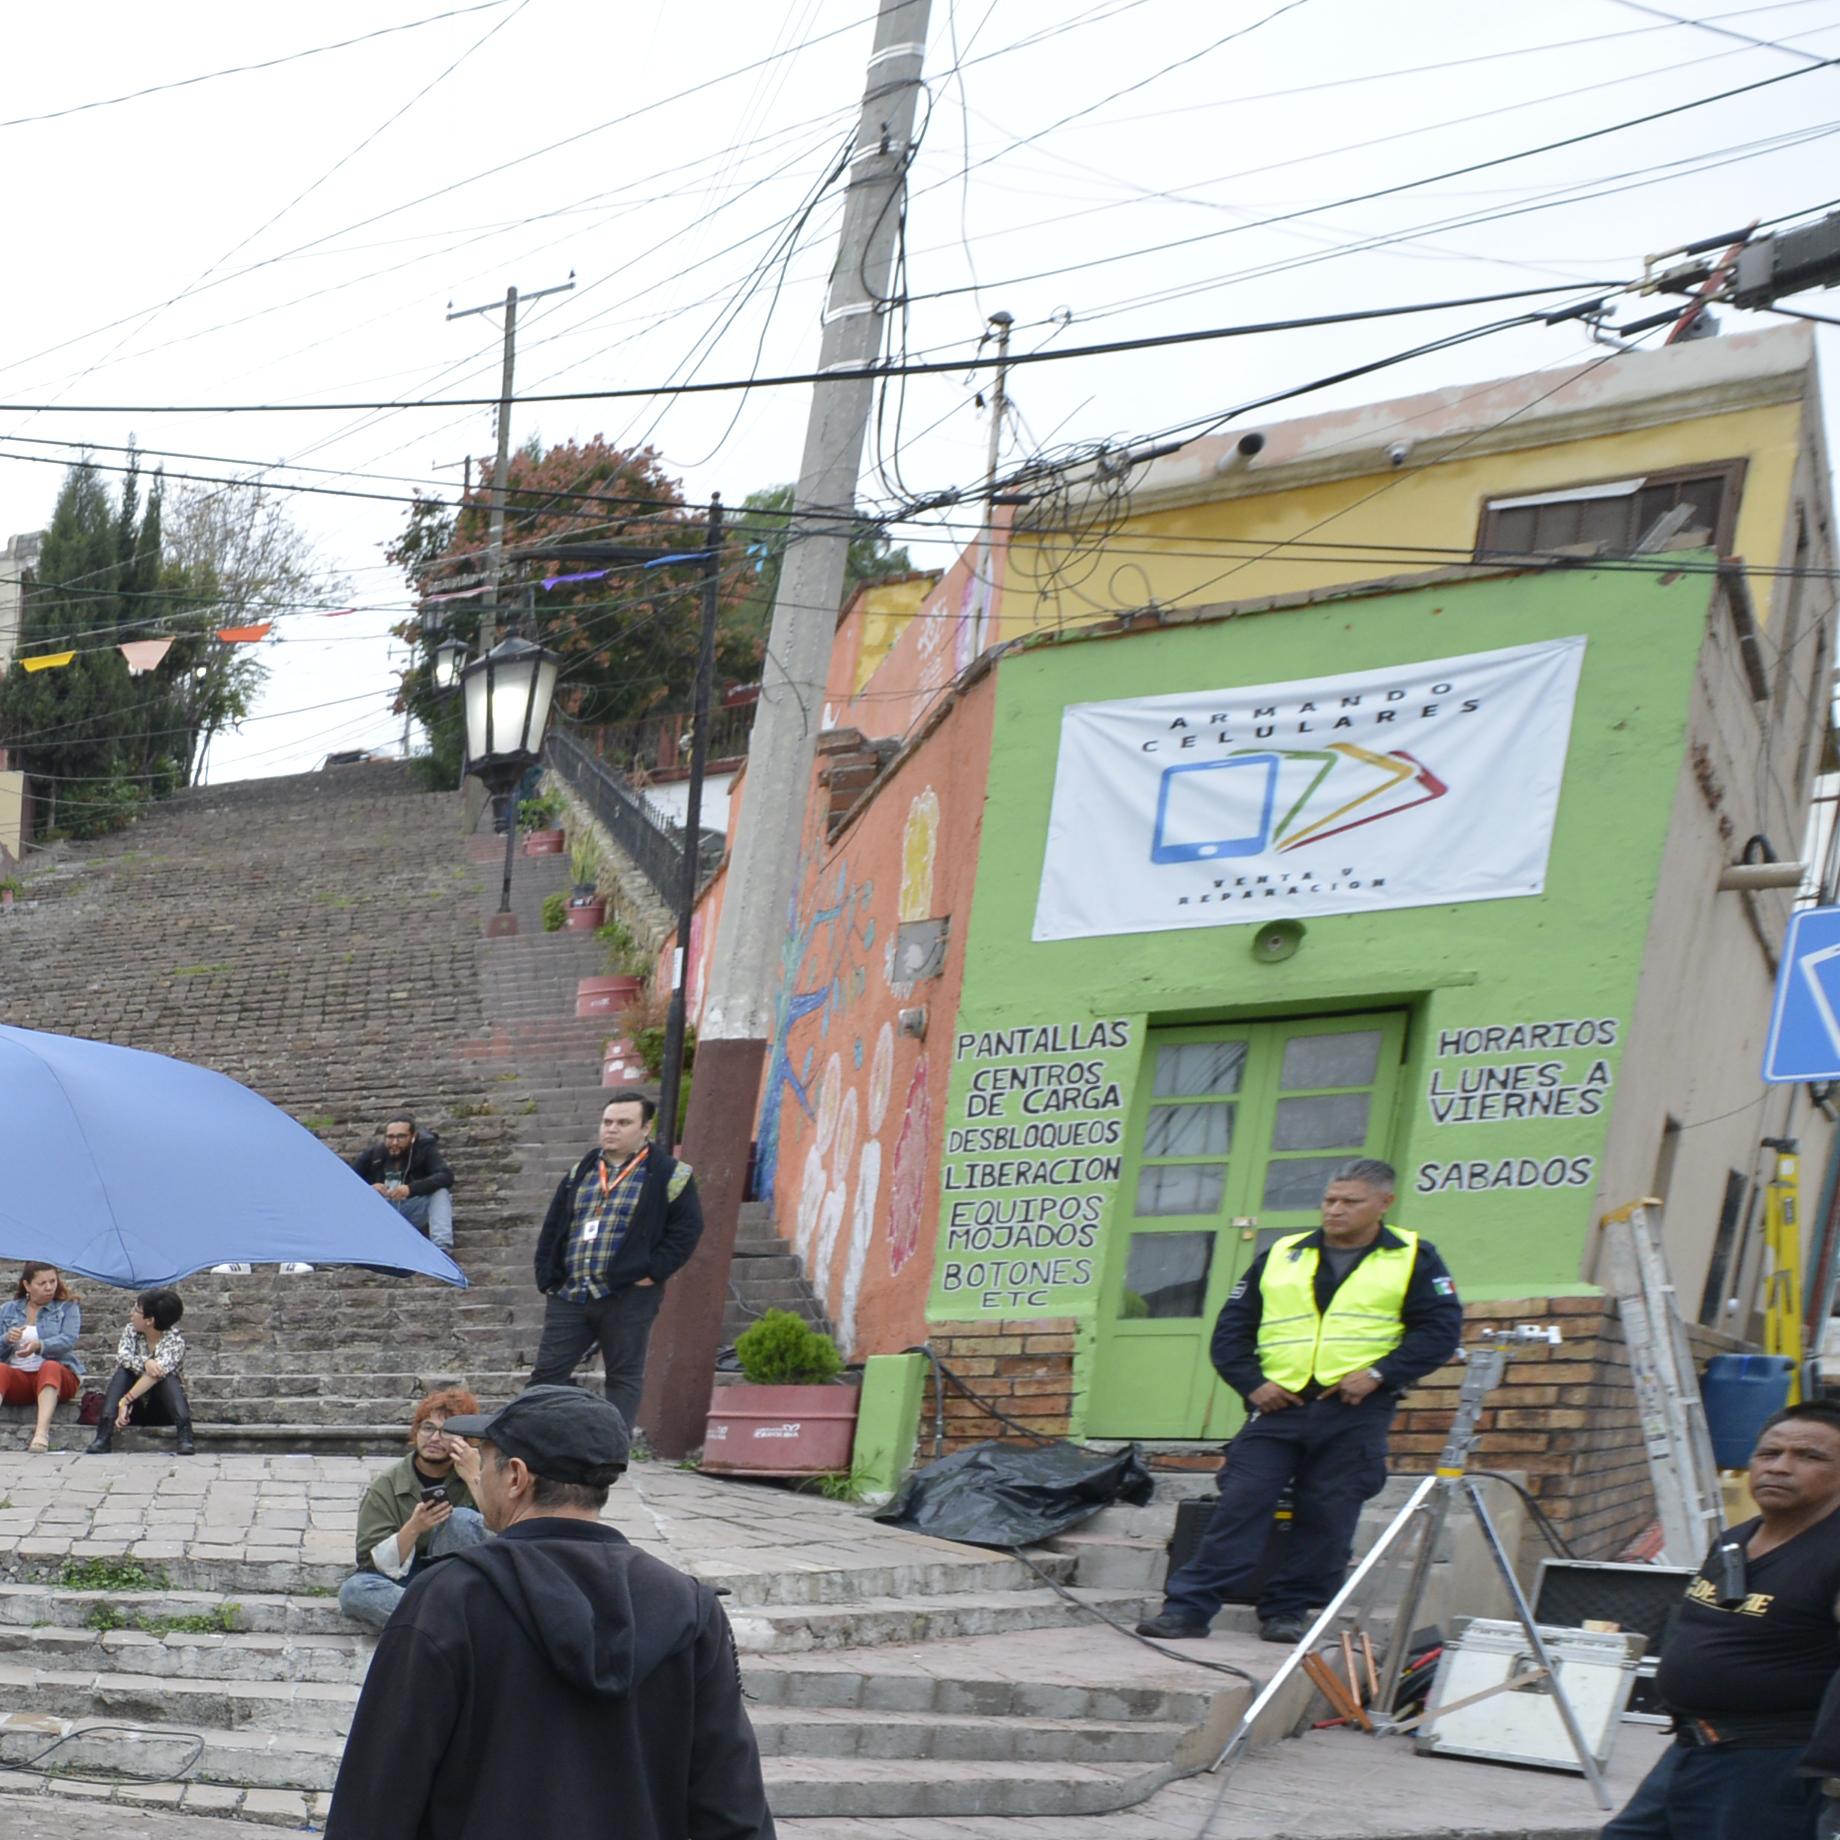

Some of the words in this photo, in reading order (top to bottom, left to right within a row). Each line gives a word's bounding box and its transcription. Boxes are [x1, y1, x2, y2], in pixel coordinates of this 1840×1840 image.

[1170, 683, 1452, 731] ARMANDO
[1142, 698, 1480, 752] CELULARES
[1178, 878, 1387, 905] REPARACION
[1214, 871, 1313, 889] VENTA
[957, 1020, 1130, 1061] PANTALLAS
[1438, 1018, 1618, 1057] HORARIOS
[973, 1061, 1105, 1092] CENTROS
[1430, 1062, 1563, 1097] LUNES
[1586, 1060, 1609, 1087] A
[966, 1092, 1006, 1119] DE
[1022, 1084, 1121, 1114] CARGA
[1430, 1087, 1605, 1124] VIERNES
[948, 1120, 1121, 1153] DESBLOQUEOS
[944, 1156, 1122, 1190] LIBERACION
[1416, 1157, 1593, 1193] SABADOS
[950, 1195, 1104, 1228] EQUIPOS
[947, 1223, 1099, 1251] MOJADOS
[943, 1258, 1093, 1291] BOTONES
[981, 1290, 1050, 1308] ETC
